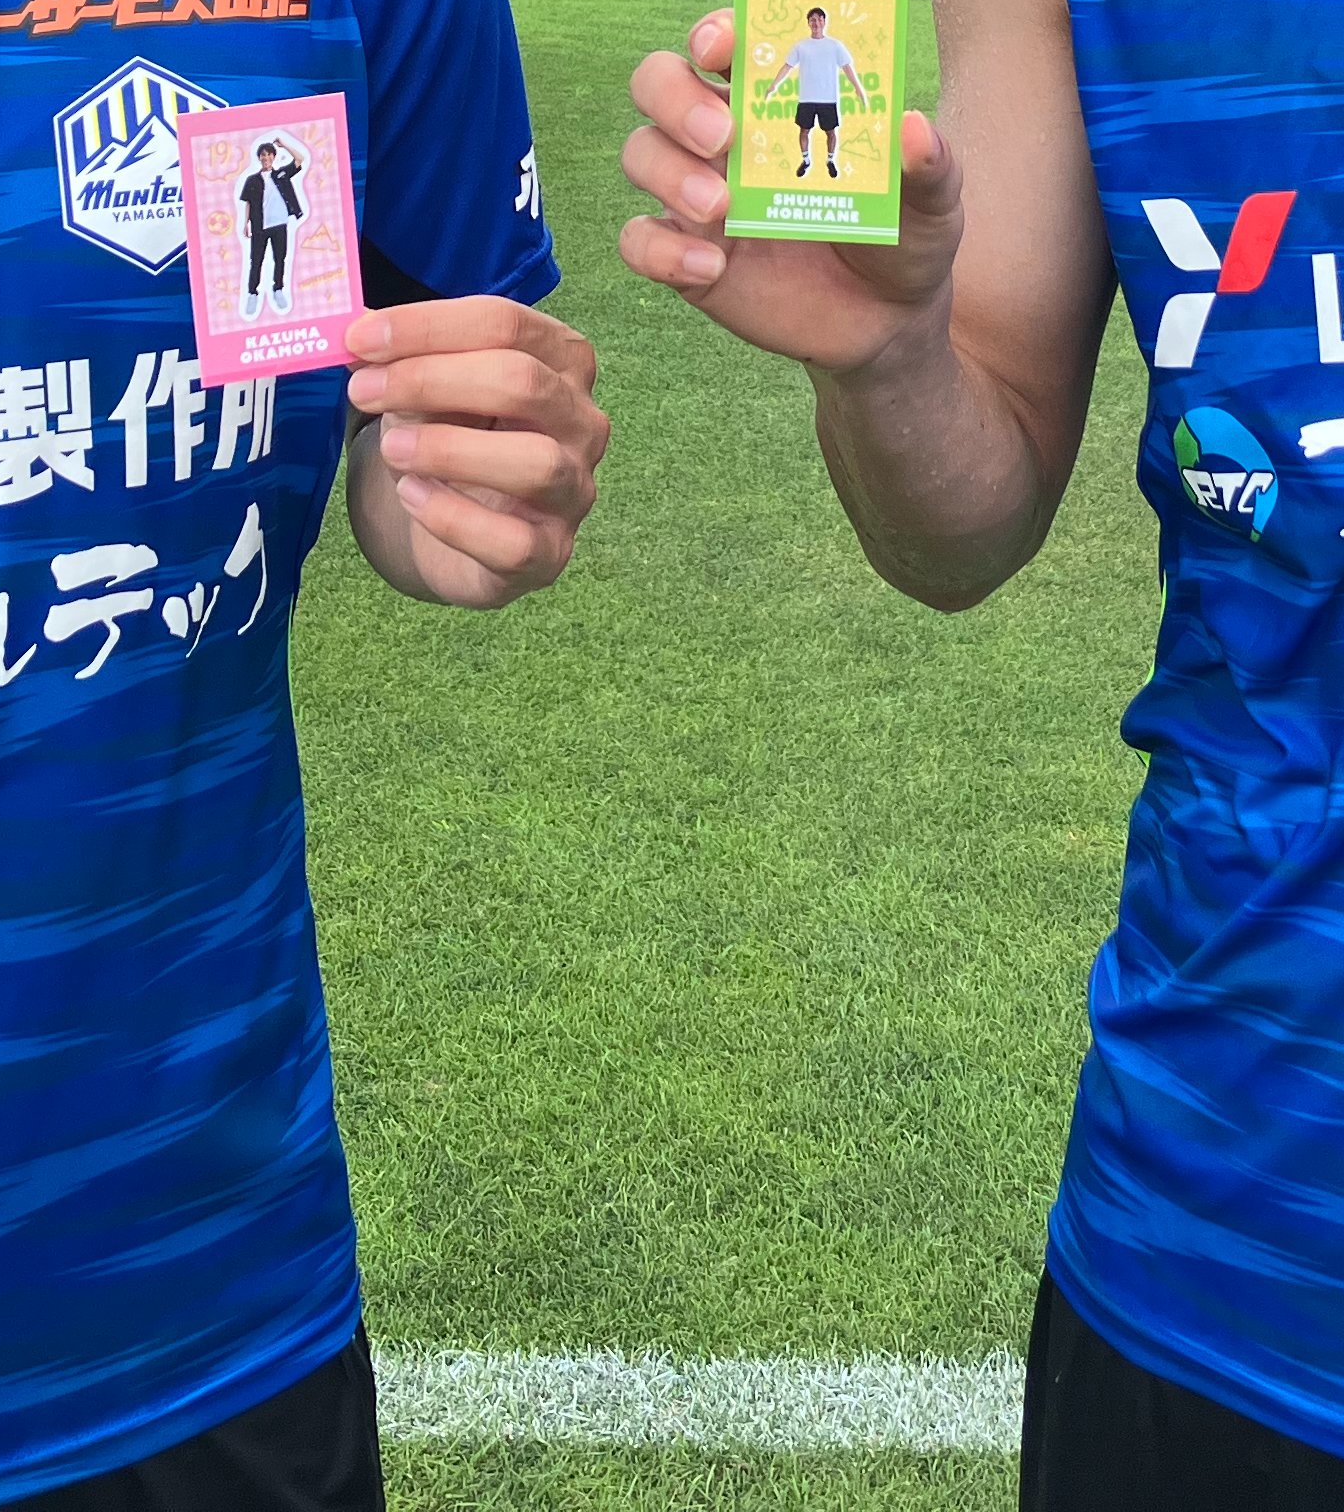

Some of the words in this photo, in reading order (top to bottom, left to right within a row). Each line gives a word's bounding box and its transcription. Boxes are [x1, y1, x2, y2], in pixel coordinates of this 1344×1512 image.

[76, 174, 183, 210] Monte
[773, 192, 854, 209] SHUMMEI
[112, 206, 184, 222] YAMAGAT
[766, 206, 860, 223] HORIKANE
[245, 326, 321, 350] KAZUMA
[240, 338, 329, 364] OKAMOTO
[1182, 468, 1274, 514] RTC
